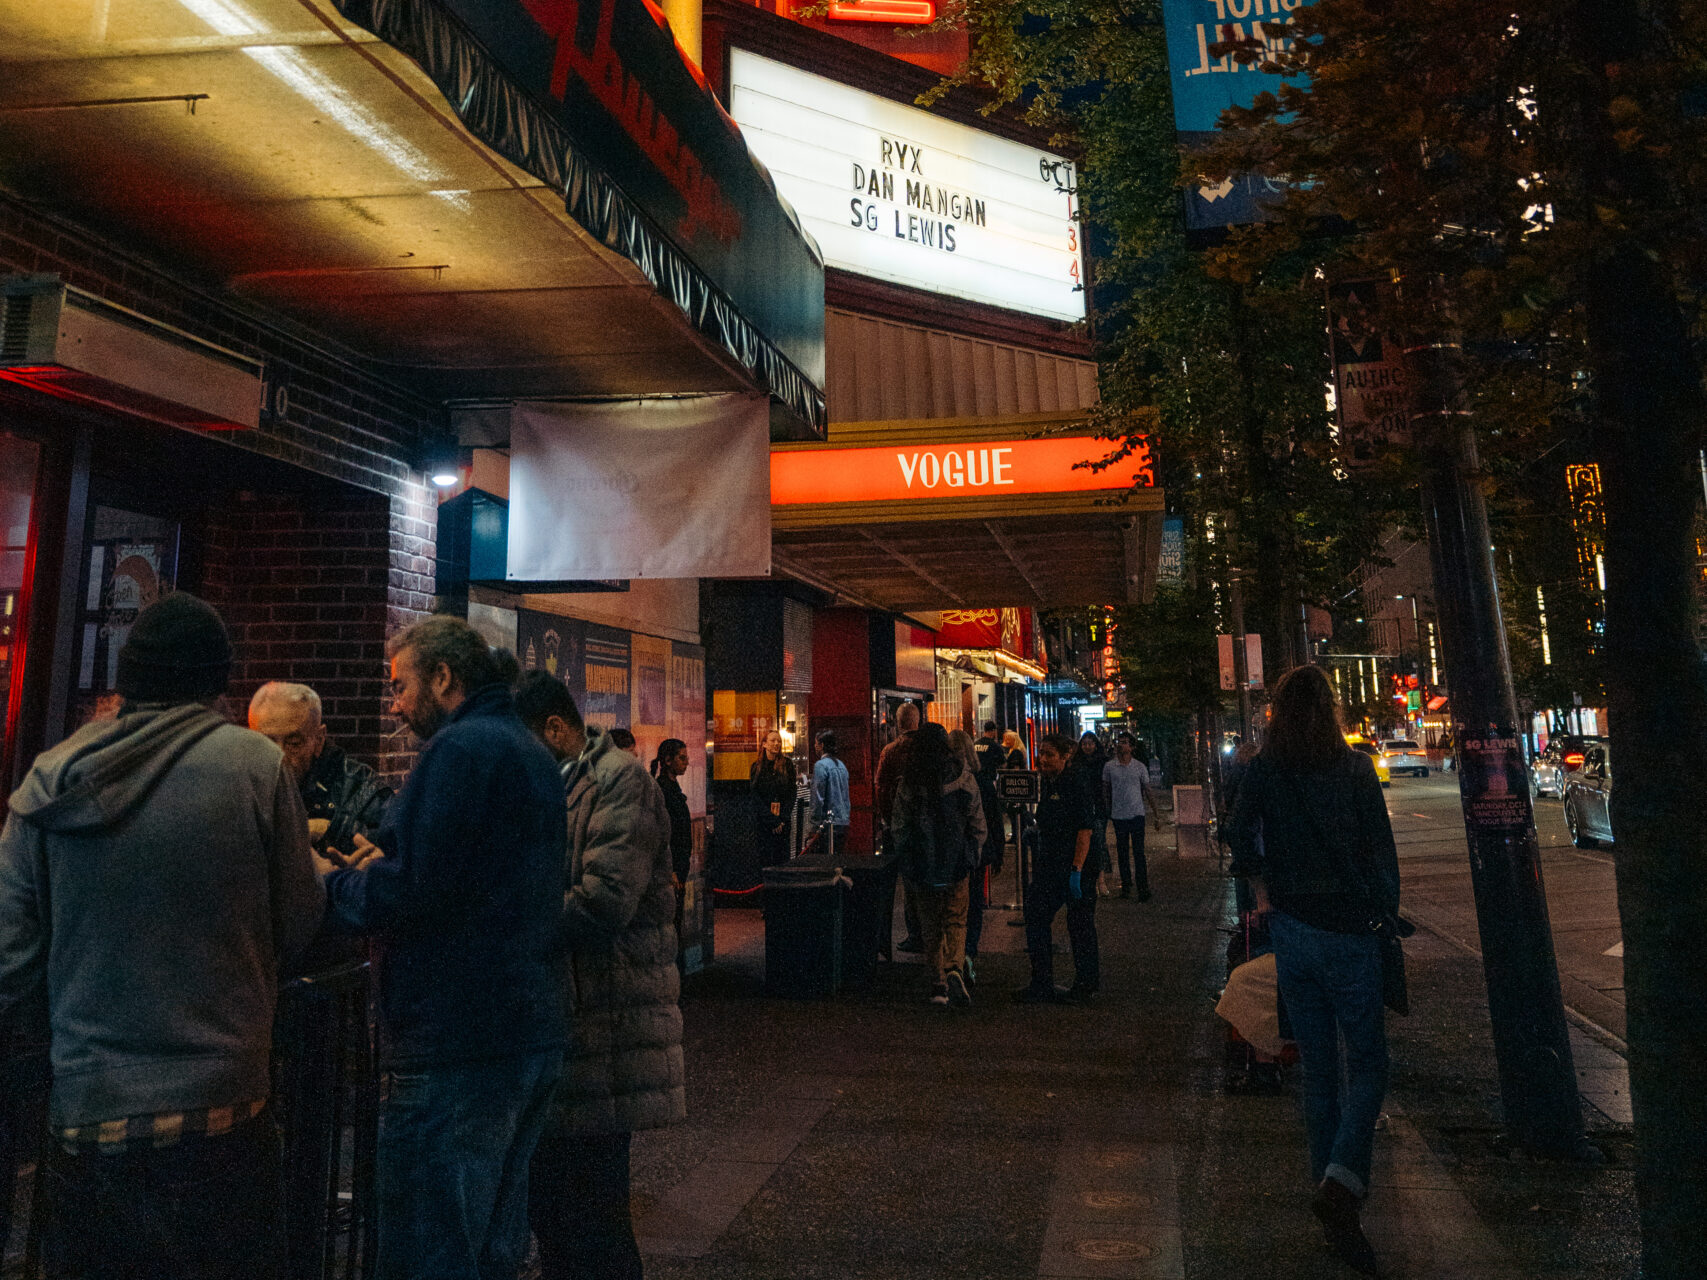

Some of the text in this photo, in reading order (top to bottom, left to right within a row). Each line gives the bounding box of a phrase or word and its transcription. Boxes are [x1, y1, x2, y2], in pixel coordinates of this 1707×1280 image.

[880, 136, 923, 175] RYX
[1040, 157, 1072, 189] OCT
[853, 163, 986, 227] DAN MANGAN
[850, 198, 956, 252] SG LEWIS
[1068, 226, 1078, 252] 3
[1070, 258, 1079, 284] 4
[897, 447, 1014, 489] VOGUE
[940, 608, 998, 626] Roxy
[1465, 738, 1517, 750] SG LEWIS
